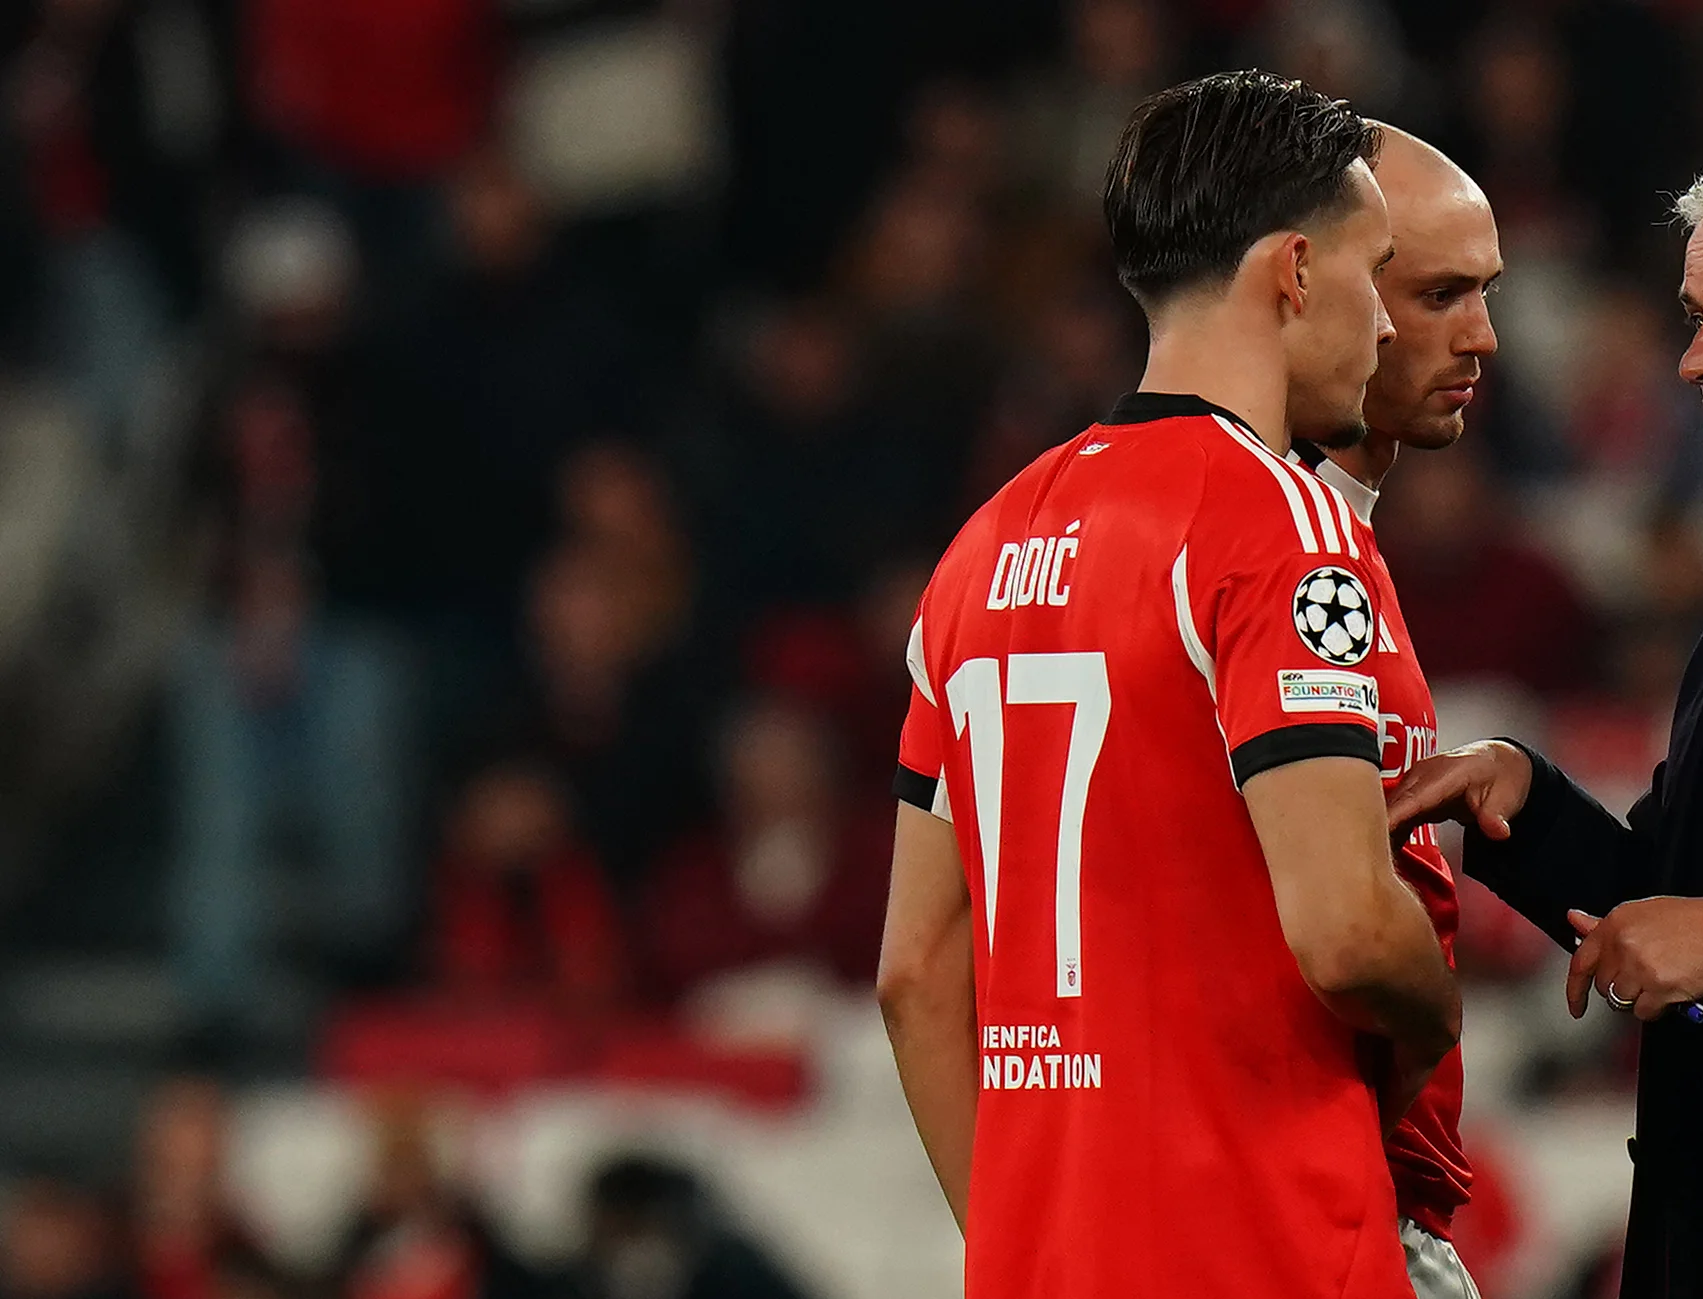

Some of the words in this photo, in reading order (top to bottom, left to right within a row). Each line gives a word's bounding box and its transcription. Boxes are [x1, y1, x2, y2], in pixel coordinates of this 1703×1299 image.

[1283, 685, 1362, 699] FOUNDATION
[1377, 711, 1437, 778] Emir
[945, 651, 1111, 998] 17
